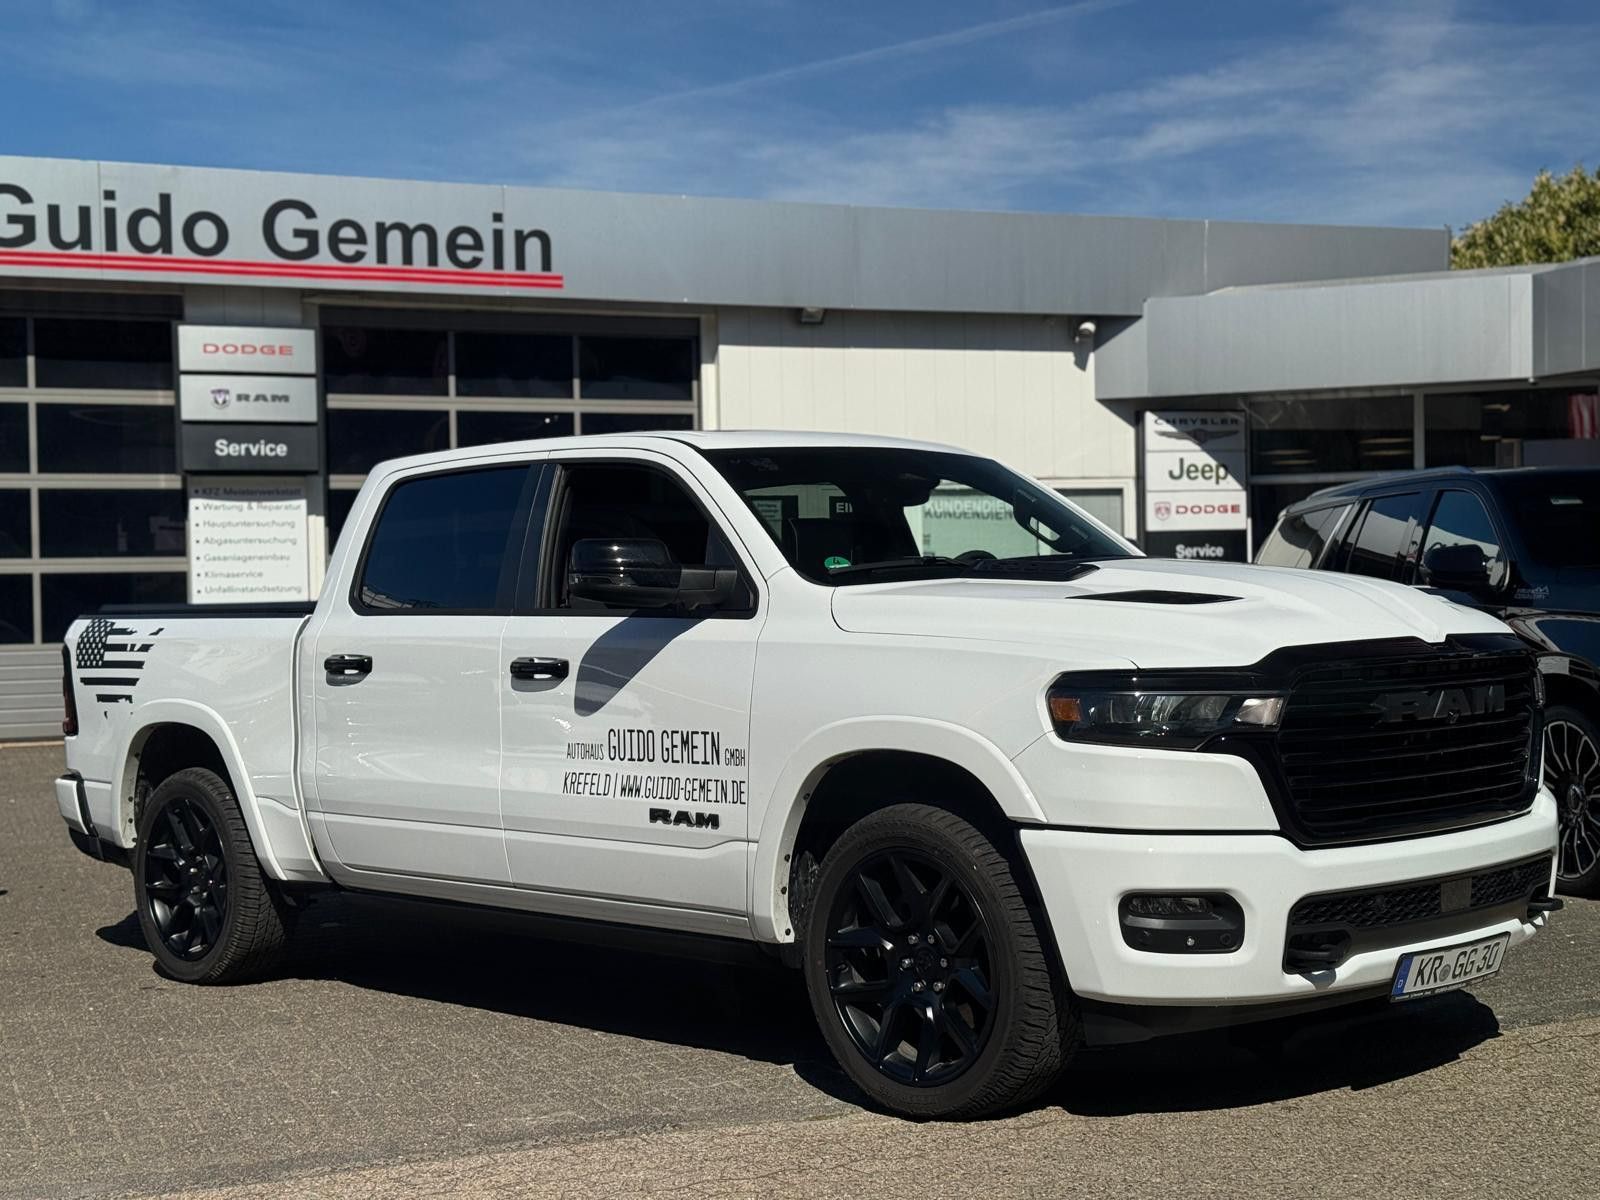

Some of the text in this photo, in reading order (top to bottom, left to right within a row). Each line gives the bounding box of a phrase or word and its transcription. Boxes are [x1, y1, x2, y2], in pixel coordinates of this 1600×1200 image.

[0, 183, 554, 273] Guido Gemein
[203, 343, 294, 356] DODGE
[235, 393, 290, 403] RAM
[1154, 417, 1239, 426] CHRYSLER
[214, 438, 288, 457] Service
[1168, 457, 1230, 485] Jeep
[202, 502, 243, 512] Wartung
[256, 501, 302, 512] Reparatur
[1175, 503, 1241, 515] DODGE
[202, 519, 297, 529] Hauptuntersuchung
[203, 536, 298, 546] Abgasuntersuchung
[1175, 544, 1225, 559] Service
[204, 571, 264, 580] Klimaservice
[566, 728, 747, 768] AUTOHAUS GUIDO GEMEIN GMBH
[562, 771, 612, 798] KREFELD
[619, 774, 747, 805] WWW.GUIDO-GEMEIN.DE
[649, 807, 721, 831] RAM
[1413, 955, 1444, 987] KR
